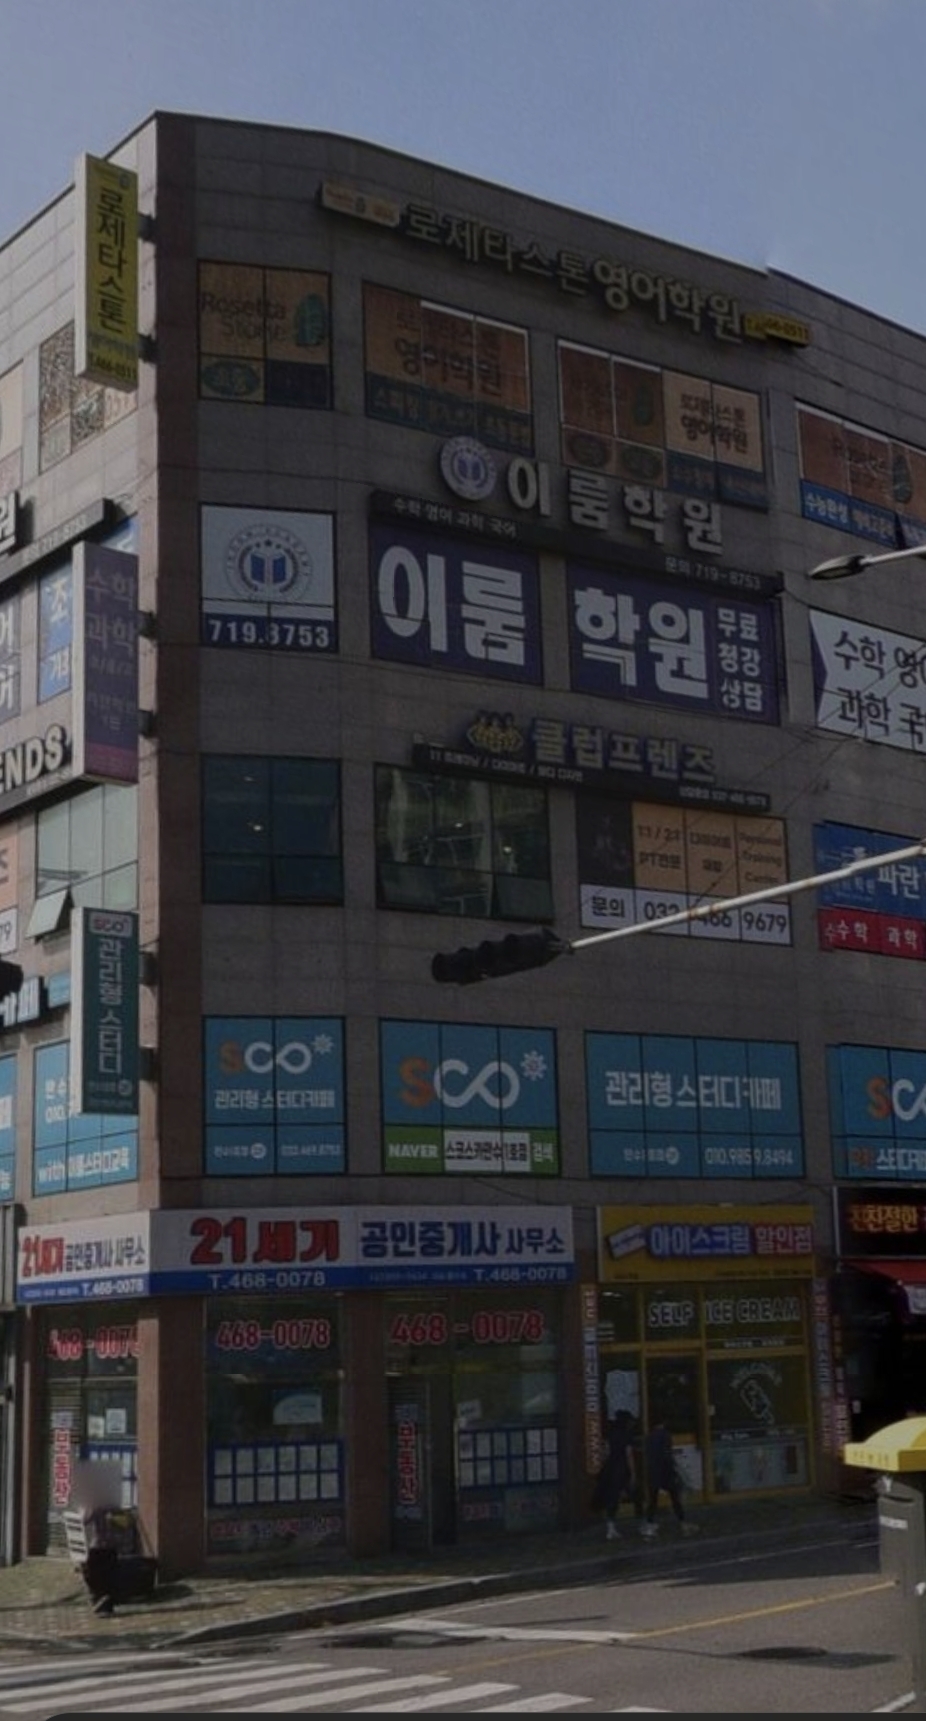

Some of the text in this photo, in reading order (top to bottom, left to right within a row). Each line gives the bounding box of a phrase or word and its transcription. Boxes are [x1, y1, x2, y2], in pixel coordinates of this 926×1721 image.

[97, 186, 127, 334] 로제타스톤
[85, 568, 136, 612] 수학
[85, 612, 136, 660] 과학
[208, 618, 330, 648] 719.8753
[717, 607, 759, 641] 무료
[718, 643, 761, 677] 청강
[834, 631, 886, 680] 수학
[720, 678, 763, 712] 상담
[837, 687, 891, 736] 과학
[535, 718, 716, 784] 클럽프렌즈
[592, 896, 625, 917] 문의
[743, 911, 787, 933] 9679
[388, 1143, 438, 1158] NAVER
[533, 1142, 554, 1163] 검색
[190, 1216, 566, 1266] 21세기 공인중개사 사무소
[650, 1221, 812, 1256] 아이스크림 할인점
[65, 1240, 113, 1272] 공인중개사
[81, 1277, 144, 1297] T.468-0078
[208, 1270, 326, 1290] T.468-0078
[473, 1266, 568, 1283] T.468-0078
[648, 1299, 697, 1328] SELF
[216, 1317, 332, 1350] 468-0078
[397, 1421, 418, 1505] 부동산
